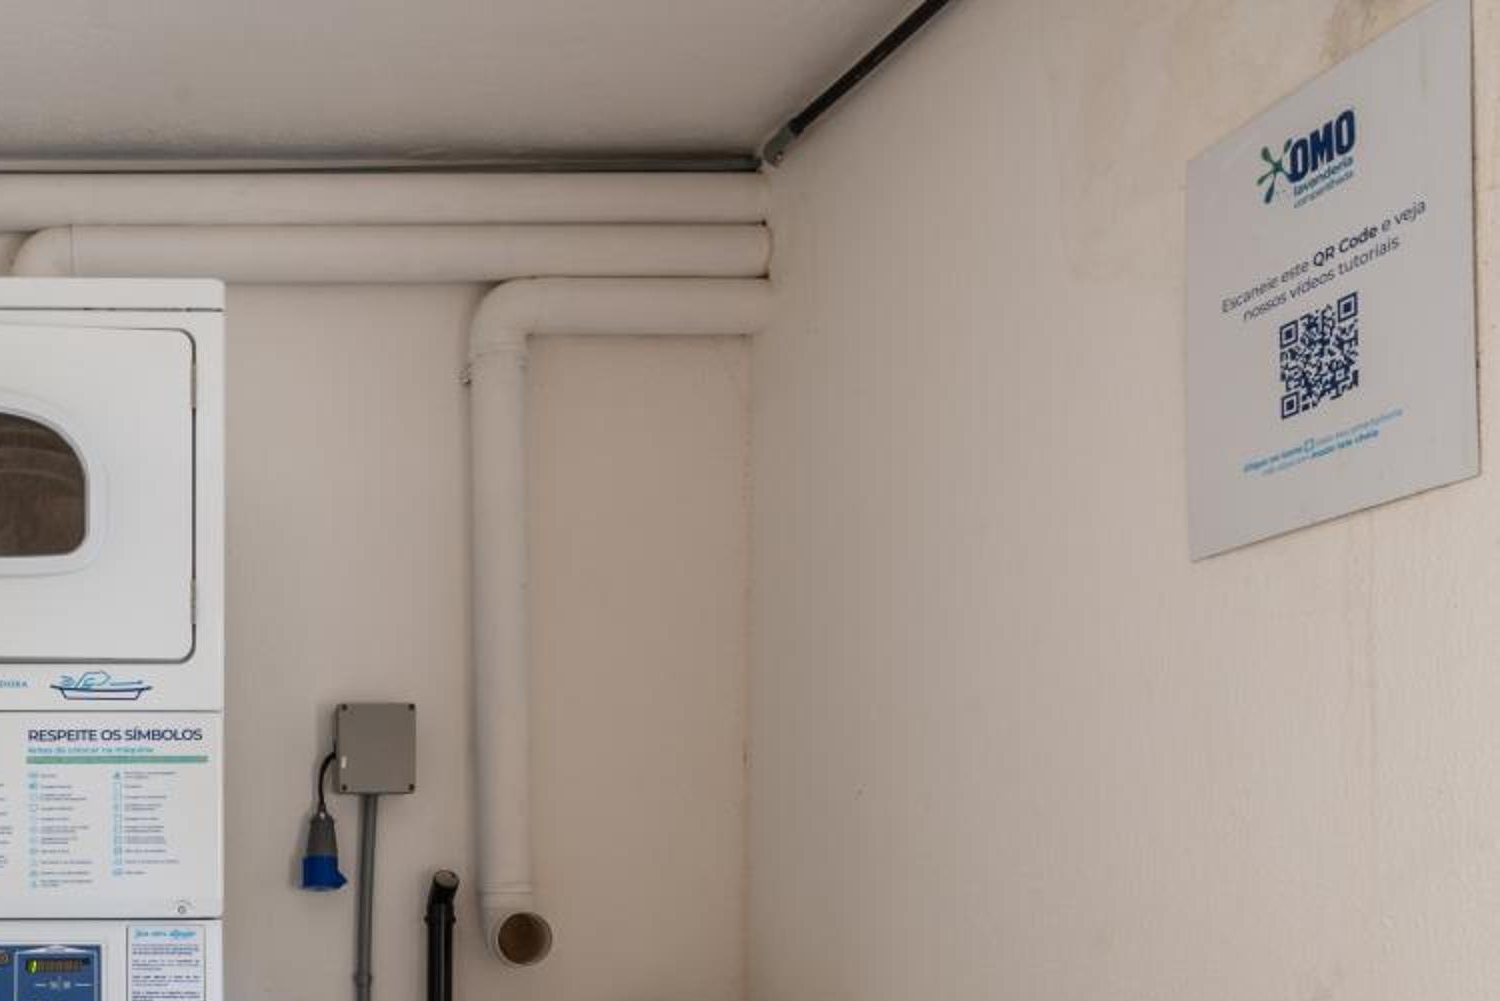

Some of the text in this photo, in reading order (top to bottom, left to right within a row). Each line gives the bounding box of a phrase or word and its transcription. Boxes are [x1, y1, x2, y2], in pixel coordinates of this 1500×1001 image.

[1289, 109, 1355, 183] OMO
[1221, 201, 1426, 313] Escaneie este QR Code e veja
[1243, 294, 1287, 321] nossos
[1338, 236, 1400, 276] tutoriais
[28, 727, 203, 742] RESPEITE OS SÍMBOLOS
